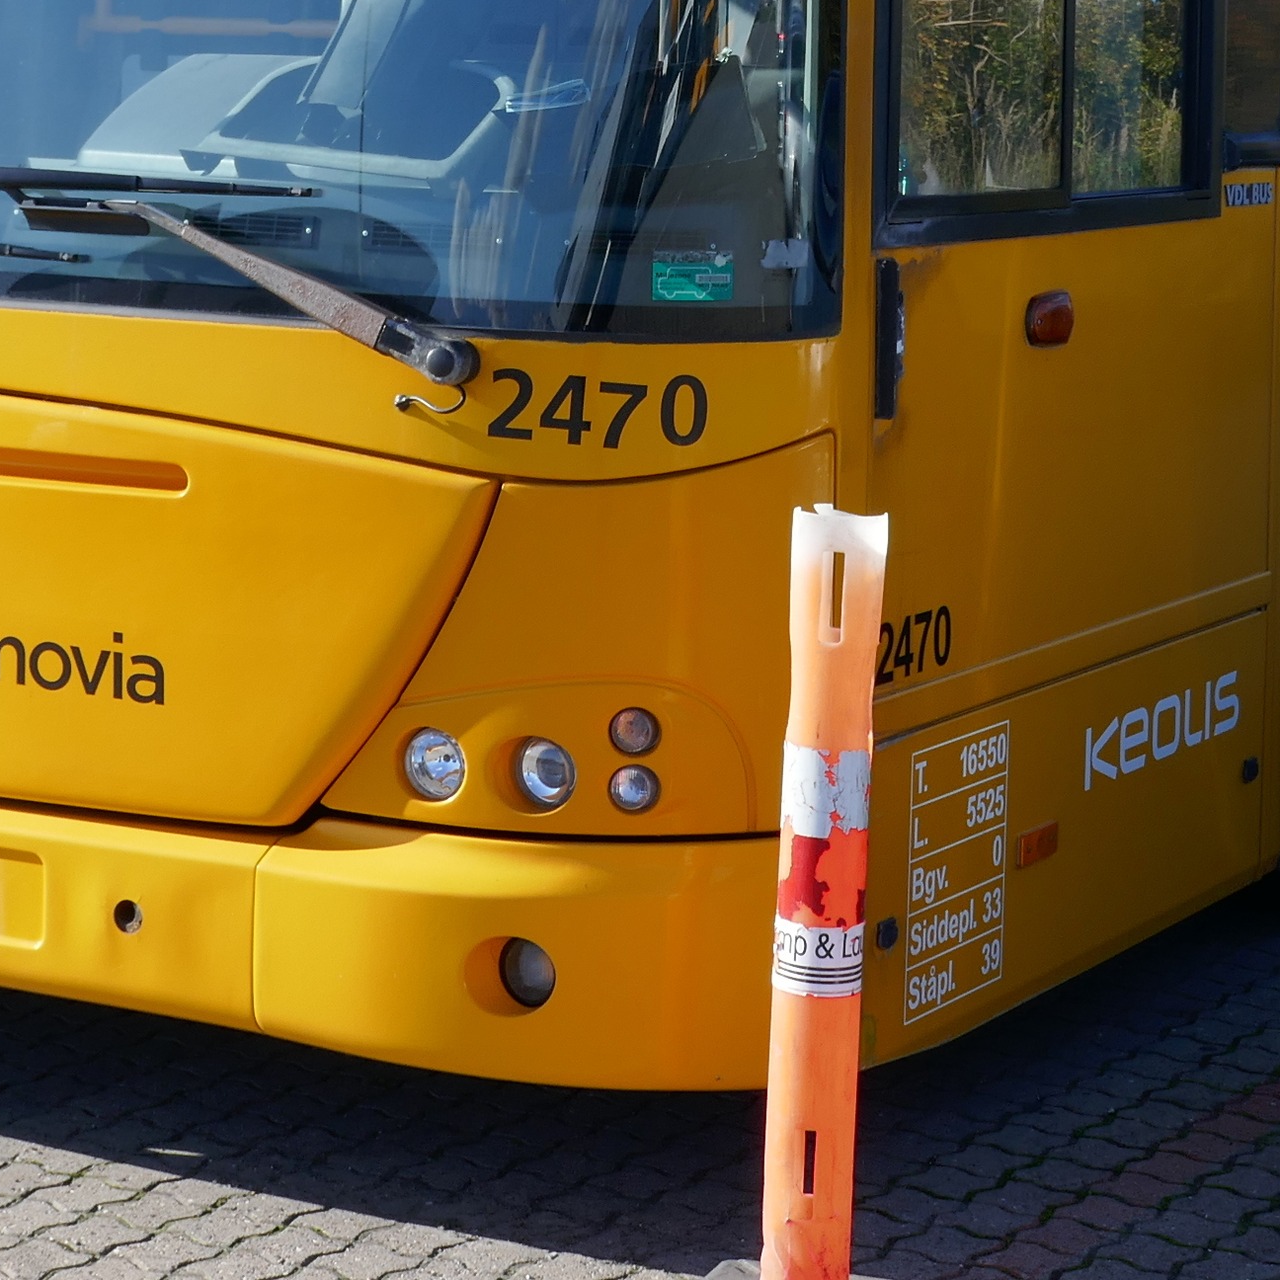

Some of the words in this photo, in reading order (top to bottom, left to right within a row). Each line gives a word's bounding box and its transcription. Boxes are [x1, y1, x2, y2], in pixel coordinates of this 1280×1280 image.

[1225, 184, 1250, 206] VDL
[1252, 183, 1273, 204] BUS
[488, 368, 707, 449] 2470
[874, 606, 952, 687] 2470
[915, 760, 928, 794] T.
[960, 732, 1007, 777] 16550
[913, 817, 928, 849] L.
[966, 784, 1005, 827] 5525
[911, 865, 949, 904] Bgv.
[992, 834, 1003, 867] 0
[815, 933, 835, 959] &
[842, 933, 863, 958] La
[910, 898, 978, 956] Siddepl.
[982, 887, 1002, 923] 33
[908, 960, 956, 1010] Ståpl.
[981, 938, 1000, 975] 39
